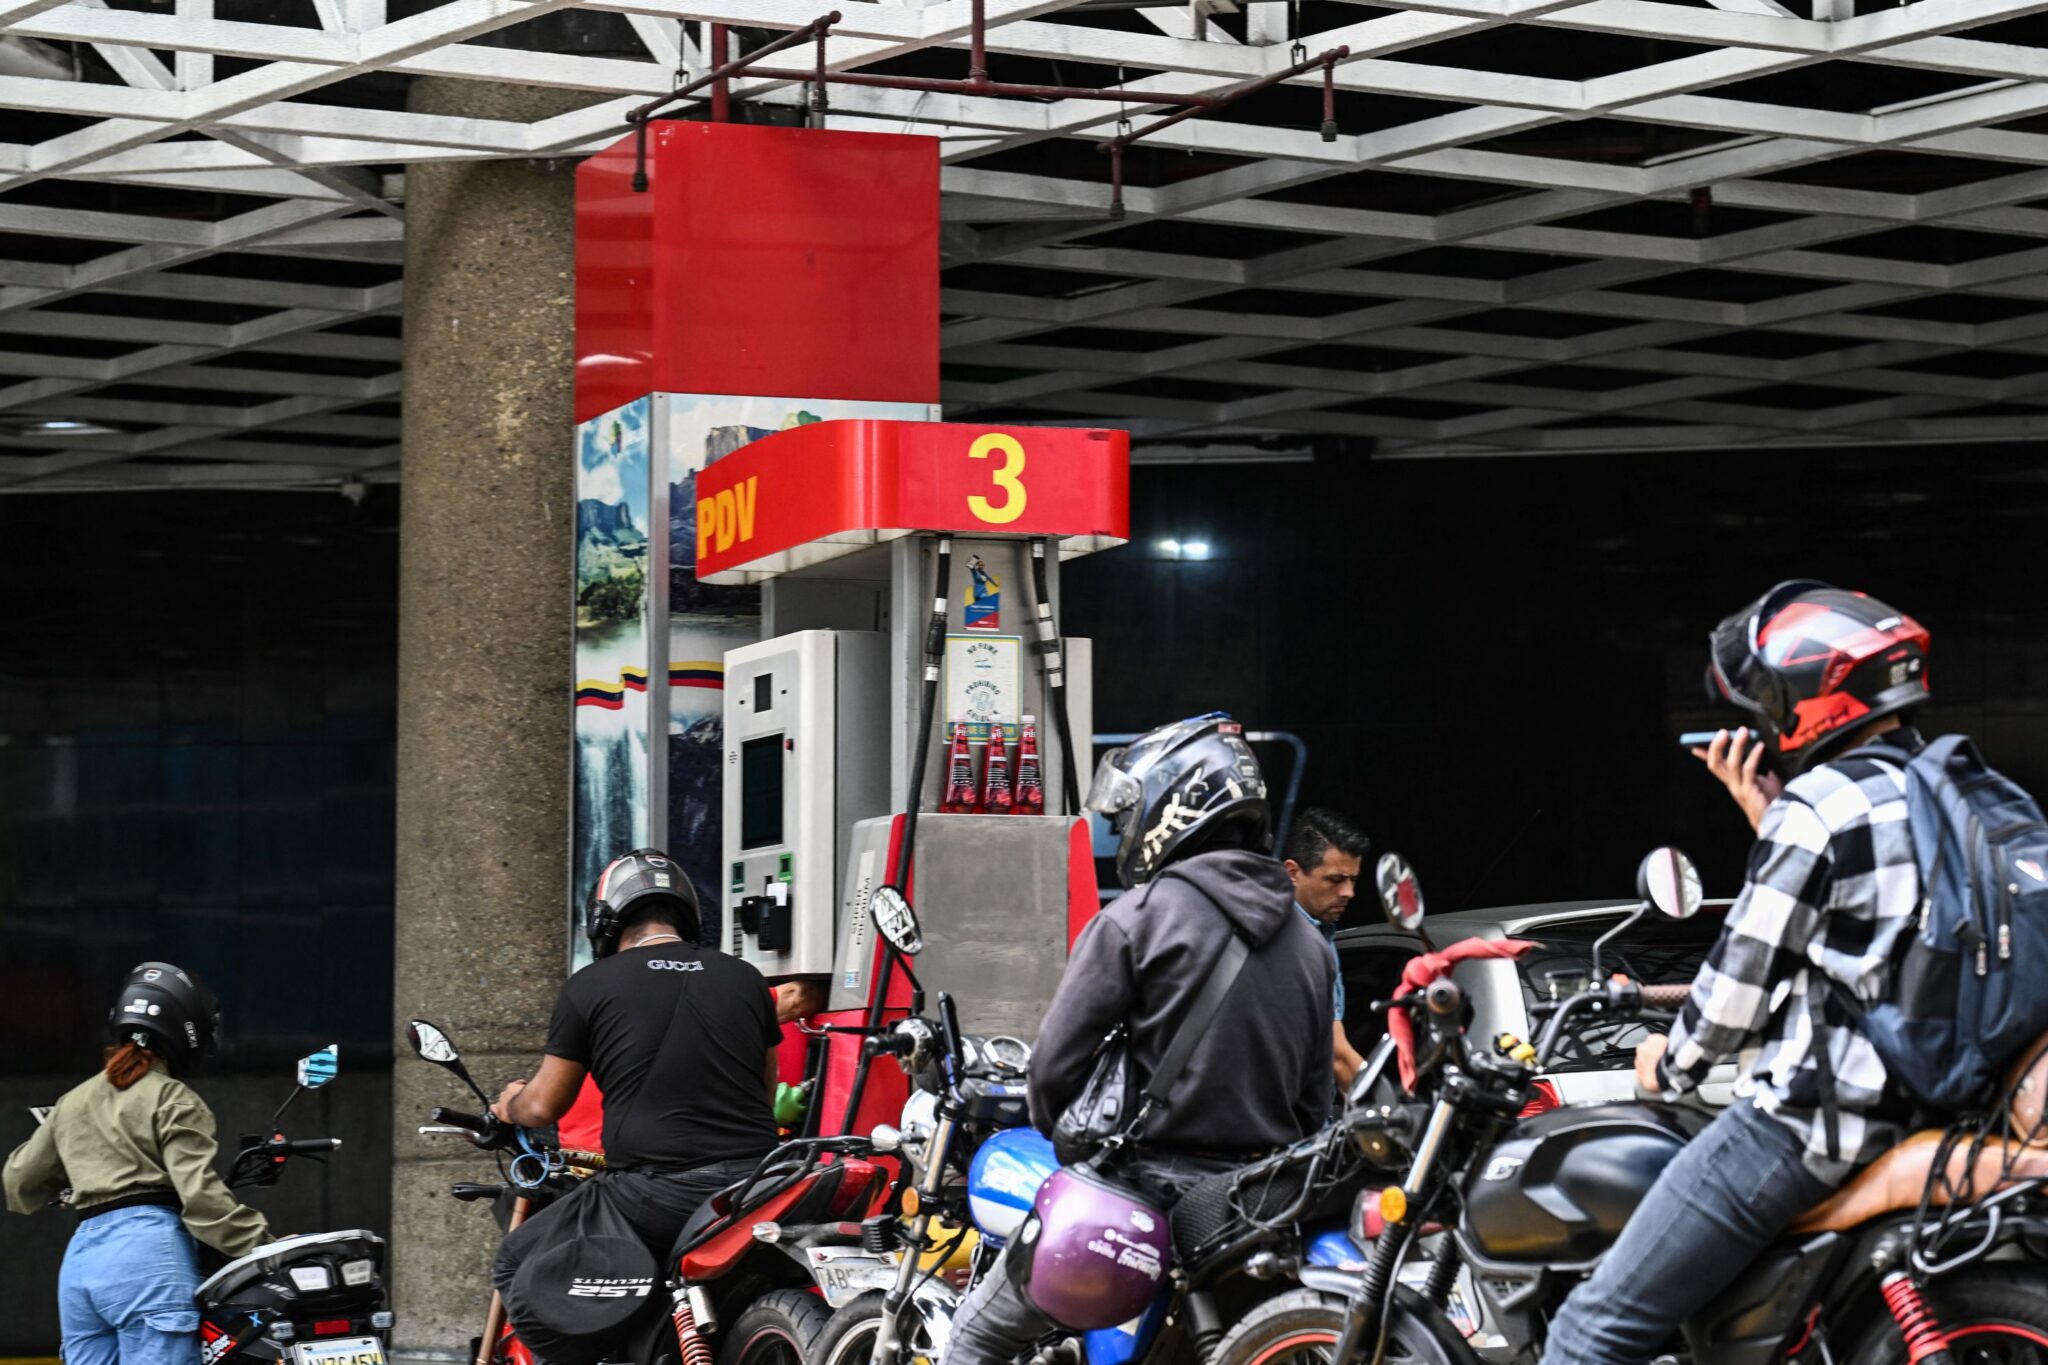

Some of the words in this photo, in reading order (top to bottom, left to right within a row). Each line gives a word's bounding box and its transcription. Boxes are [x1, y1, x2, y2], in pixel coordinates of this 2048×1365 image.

[967, 432, 1027, 524] 3
[697, 475, 758, 560] PDV
[967, 709, 999, 722] CELULR
[647, 960, 704, 971] GUCCI
[572, 1277, 654, 1285] HELMETS
[568, 1284, 652, 1298] LS2
